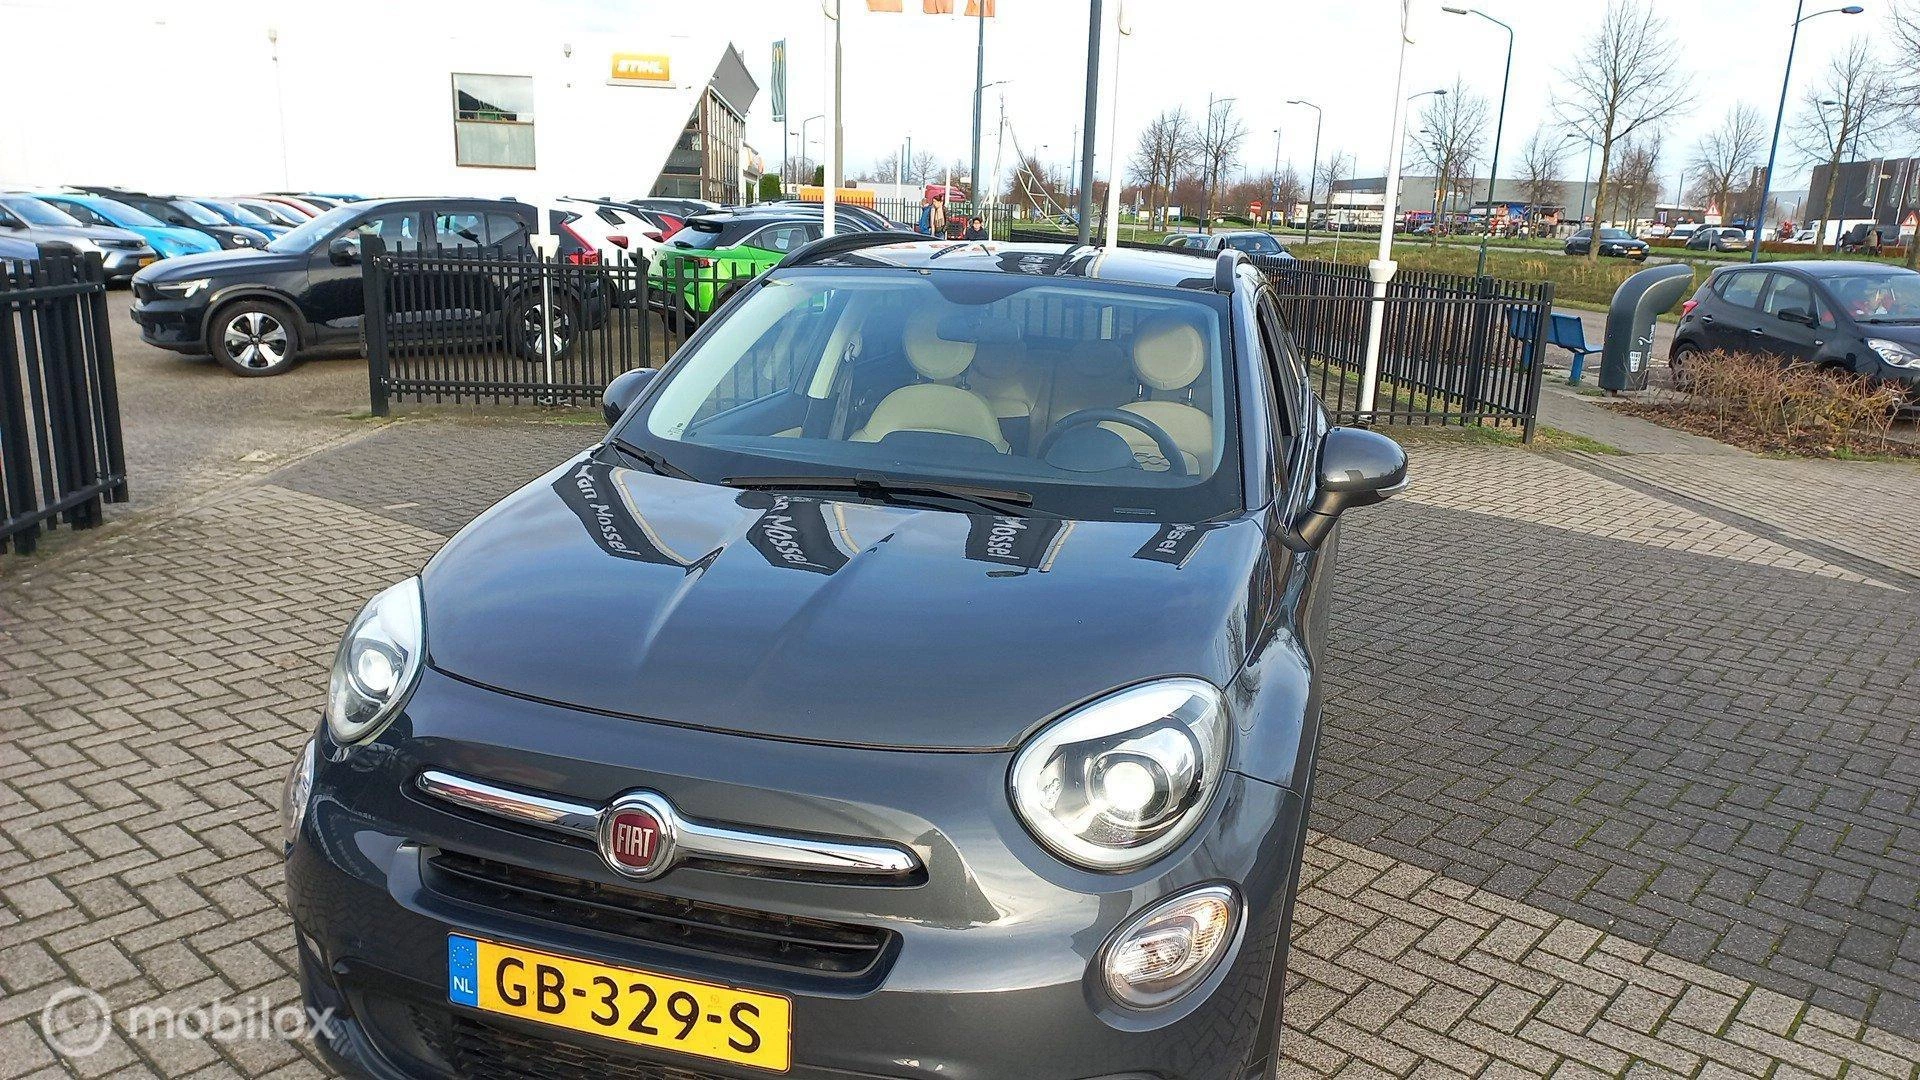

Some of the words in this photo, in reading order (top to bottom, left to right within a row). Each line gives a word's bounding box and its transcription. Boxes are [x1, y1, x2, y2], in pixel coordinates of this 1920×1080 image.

[573, 464, 599, 500] Van
[589, 503, 642, 556] Mossel
[762, 515, 835, 571] Mossel
[616, 822, 654, 858] FIAT
[453, 975, 474, 995] NL
[495, 956, 762, 1054] GB-329-S
